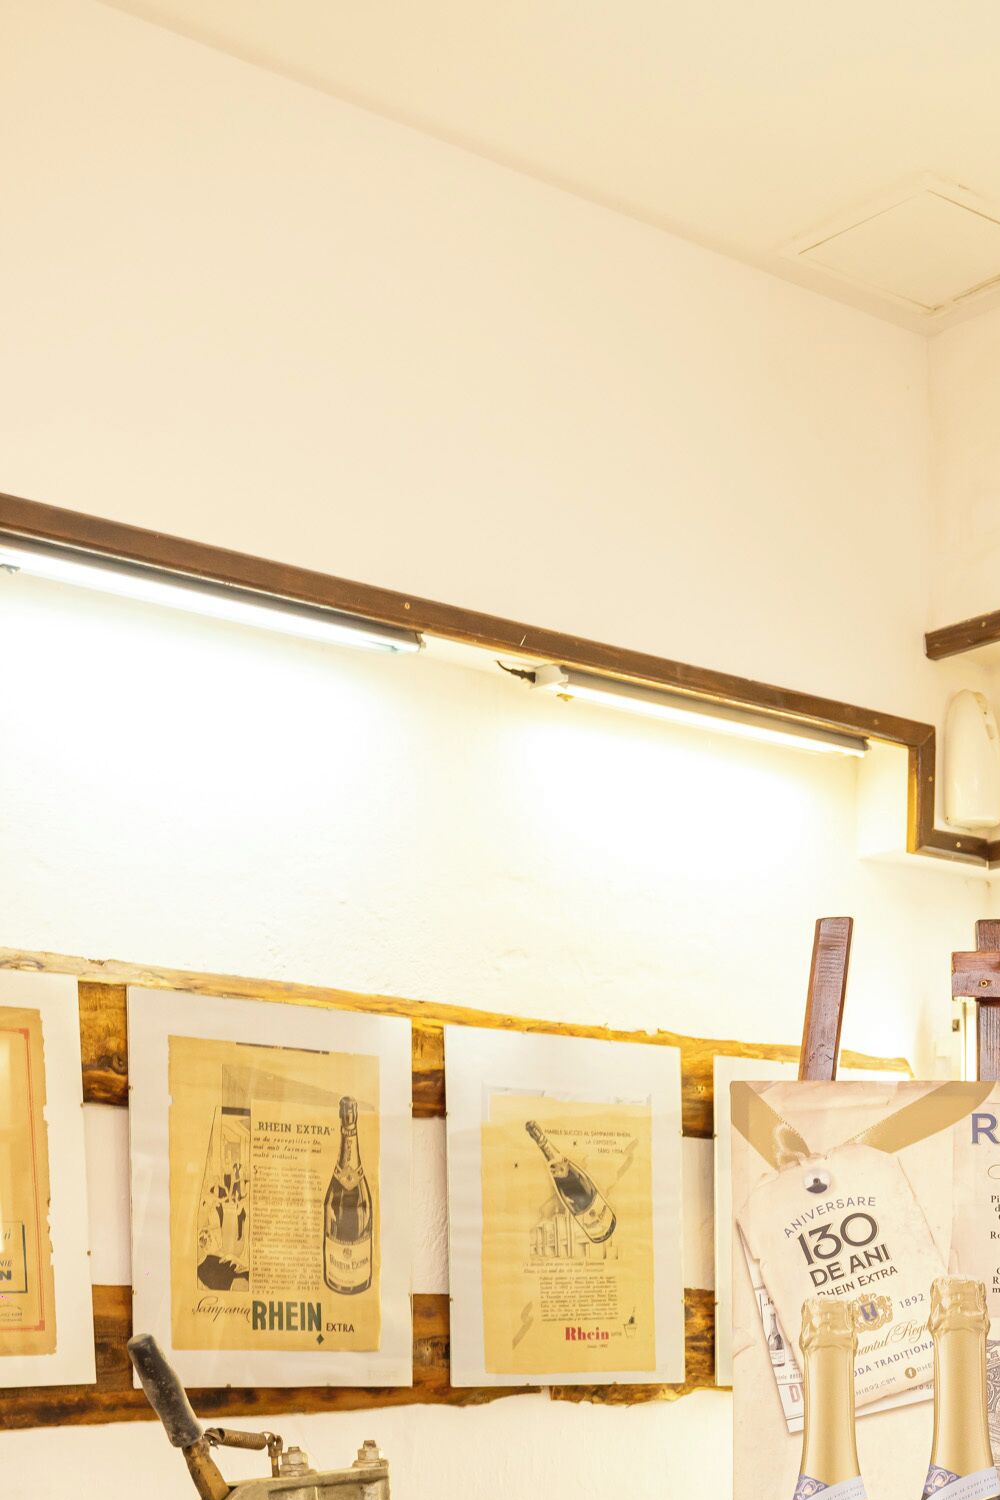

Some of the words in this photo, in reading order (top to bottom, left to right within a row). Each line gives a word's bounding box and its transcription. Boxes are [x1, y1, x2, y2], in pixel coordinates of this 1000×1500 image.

[784, 1196, 877, 1238] ANIVERSARE
[797, 1212, 878, 1266] 130
[810, 1262, 845, 1287] DE
[850, 1243, 890, 1274] ANI
[859, 1265, 898, 1286] EXTRA
[252, 1300, 322, 1332] RHEIN
[326, 1323, 355, 1332] EXTRA
[900, 1293, 925, 1308] 1892
[565, 1327, 609, 1341] Rhein
